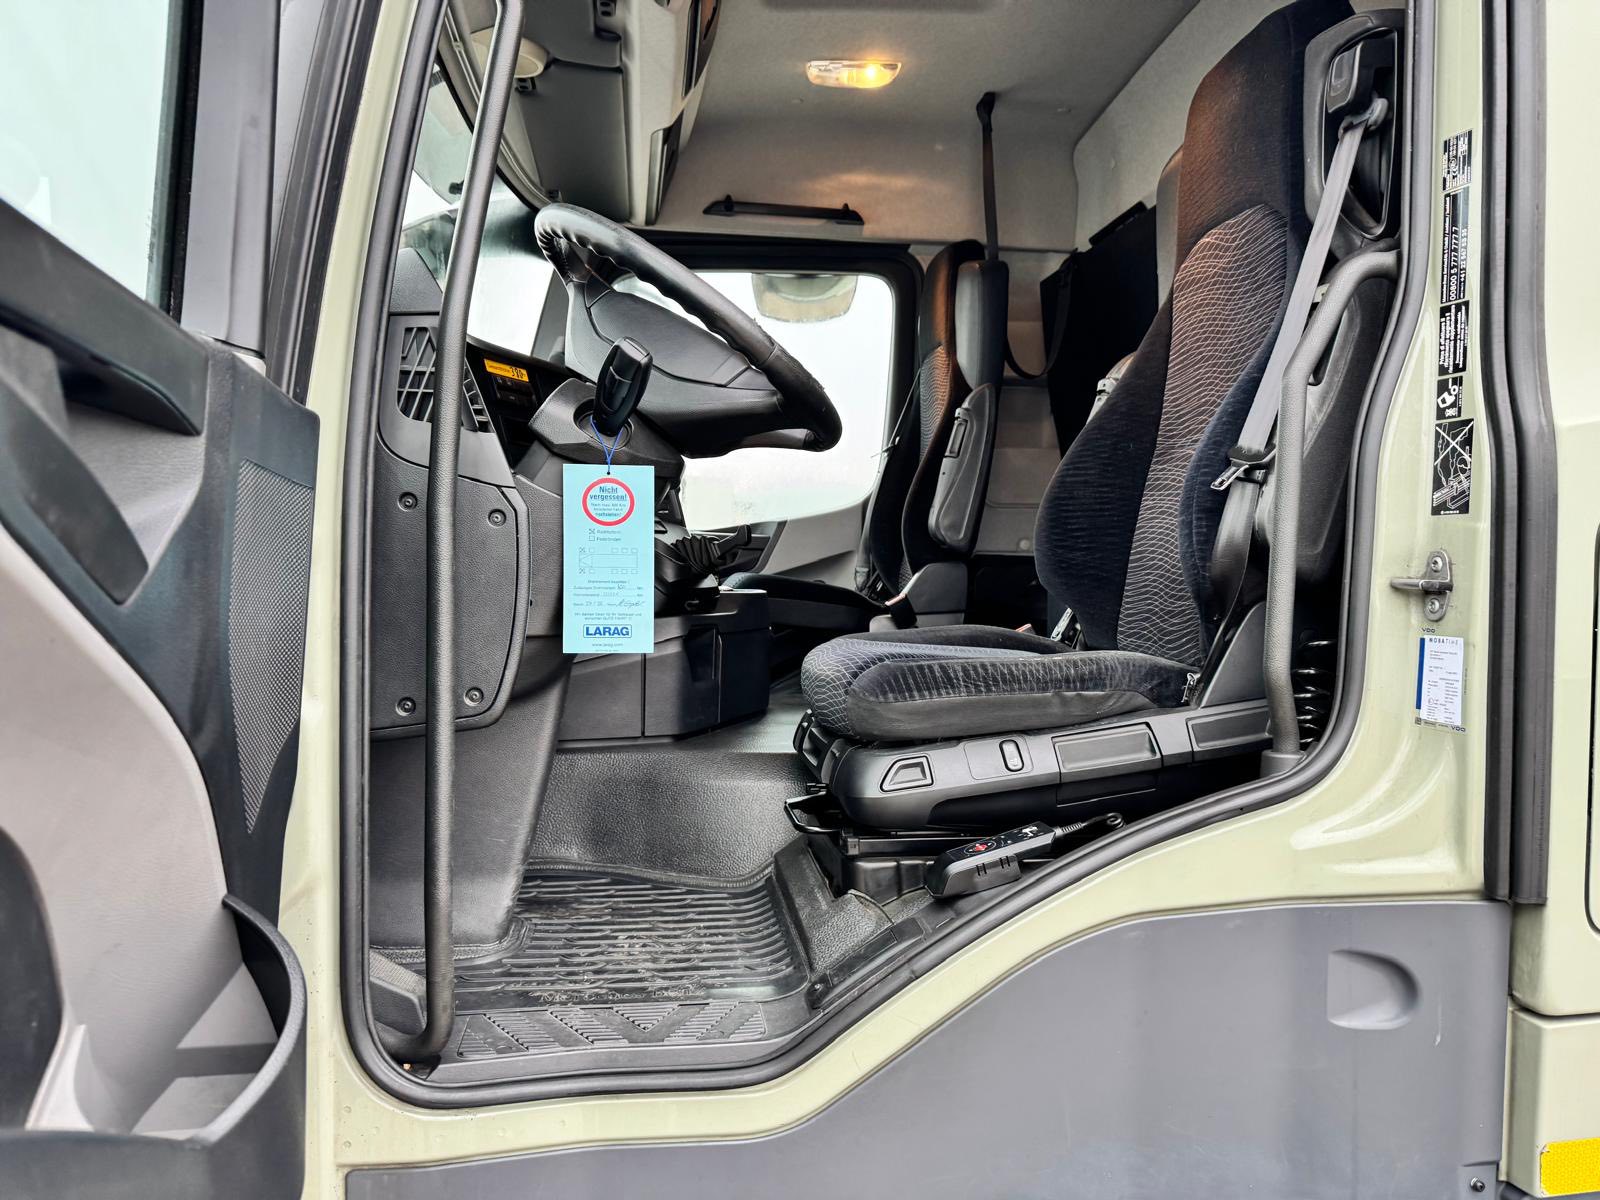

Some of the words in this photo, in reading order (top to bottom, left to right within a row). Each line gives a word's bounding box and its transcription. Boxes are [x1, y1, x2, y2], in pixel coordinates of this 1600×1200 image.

[1449, 275, 1457, 301] 00800
[599, 486, 618, 494] Nicht
[586, 627, 630, 636] LARAG
